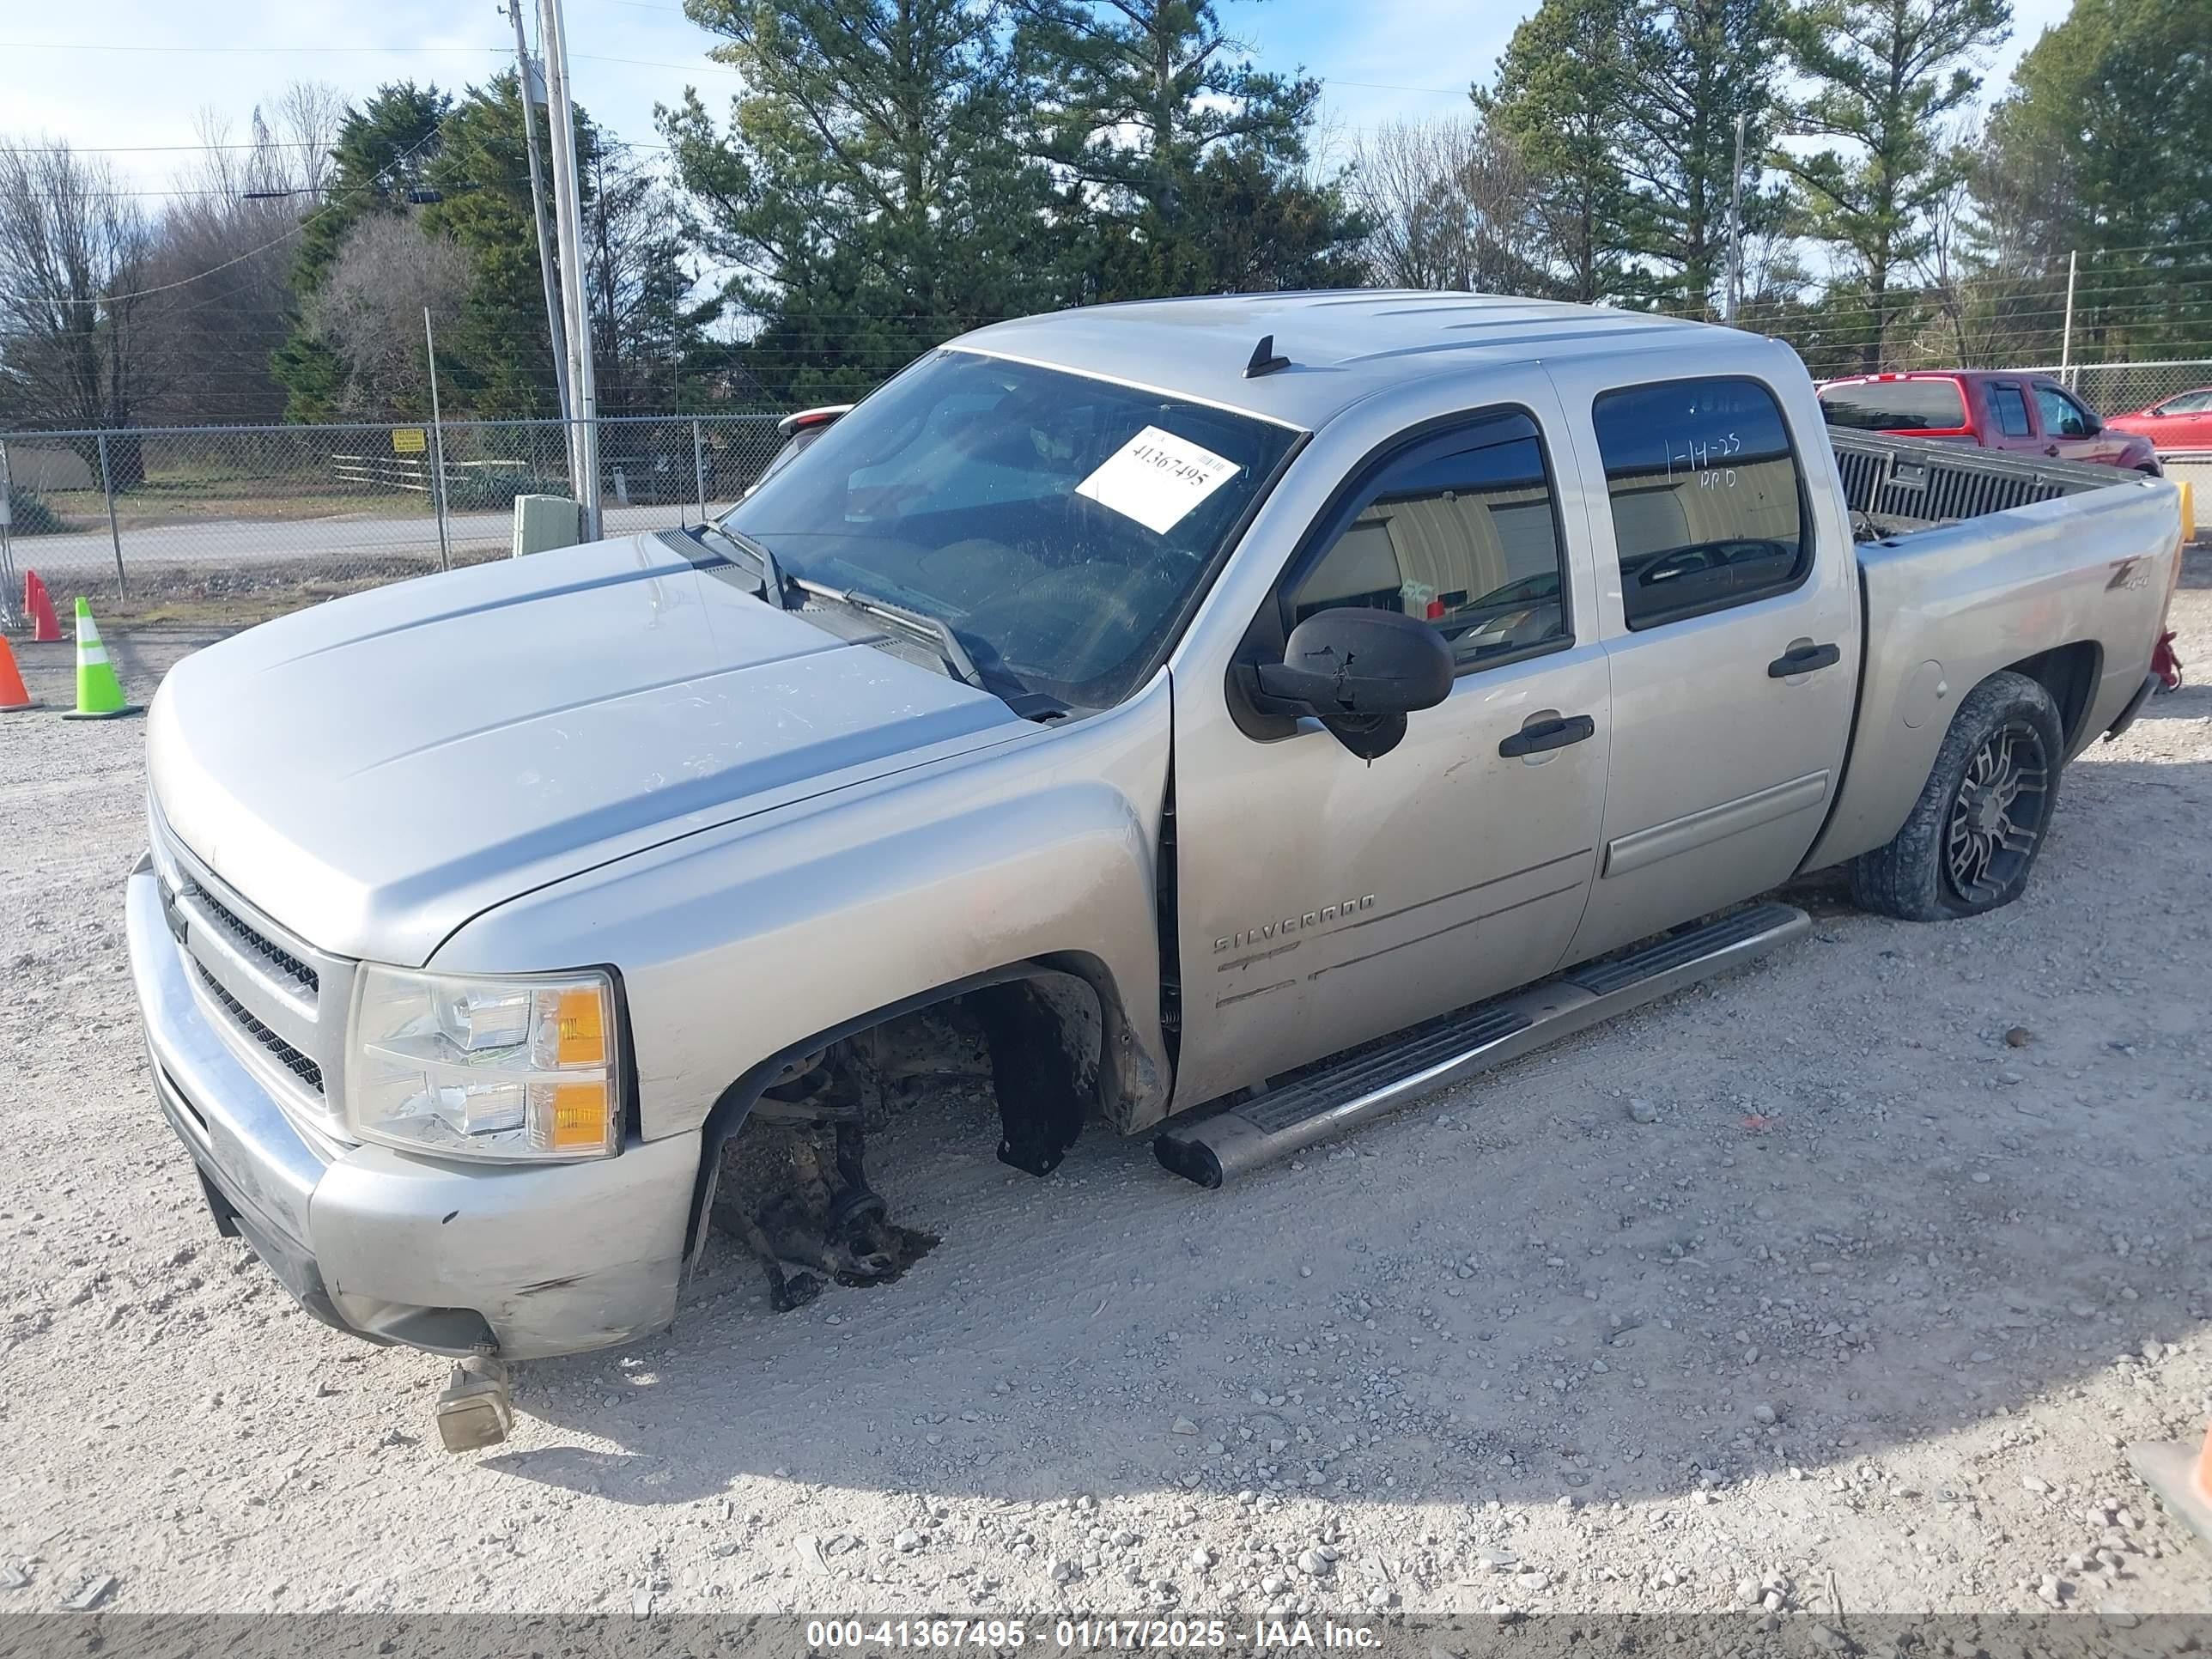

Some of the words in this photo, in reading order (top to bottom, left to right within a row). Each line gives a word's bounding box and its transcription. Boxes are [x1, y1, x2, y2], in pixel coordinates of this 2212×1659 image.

[1133, 445, 1209, 486] 41367495
[1665, 433, 1740, 483] 1-14-25
[1213, 893, 1375, 954] SILVERADO
